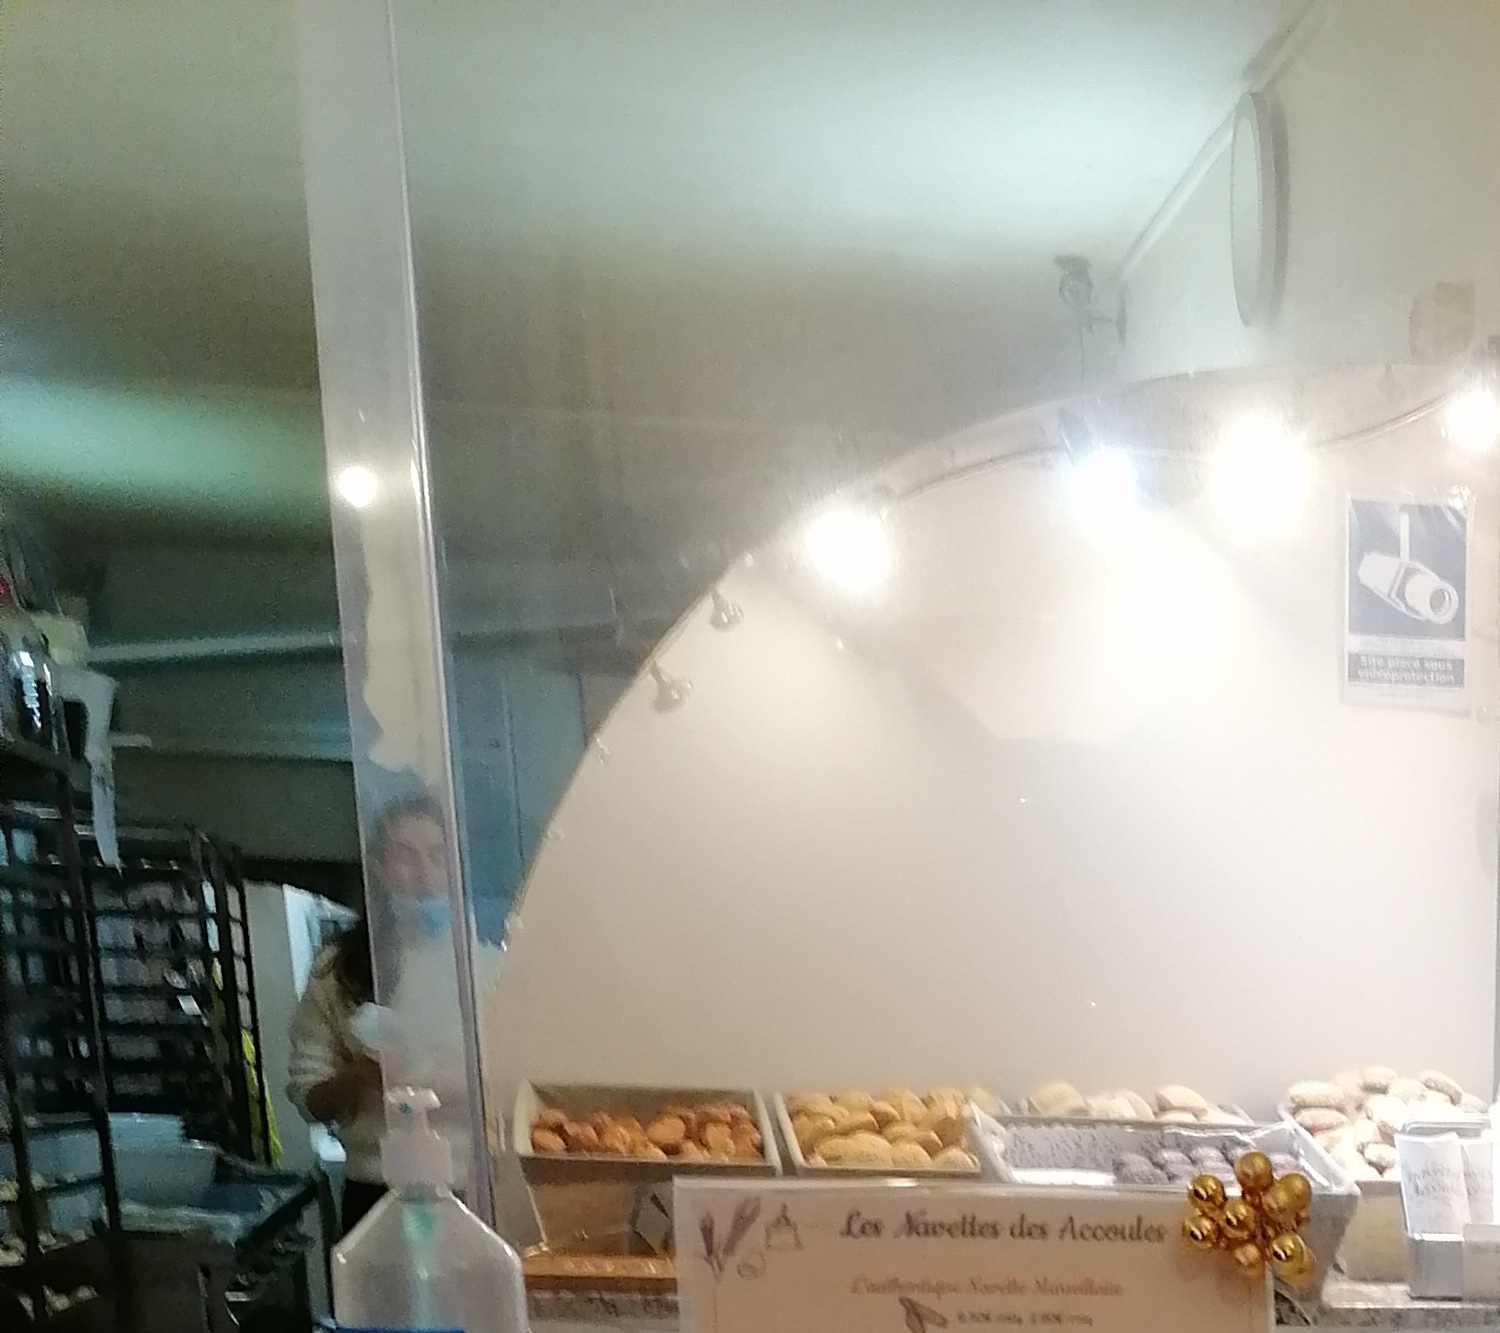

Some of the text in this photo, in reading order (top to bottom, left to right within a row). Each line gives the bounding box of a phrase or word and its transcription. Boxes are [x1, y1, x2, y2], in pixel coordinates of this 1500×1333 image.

[839, 1208, 1166, 1243] Les Navettes des Accoules
